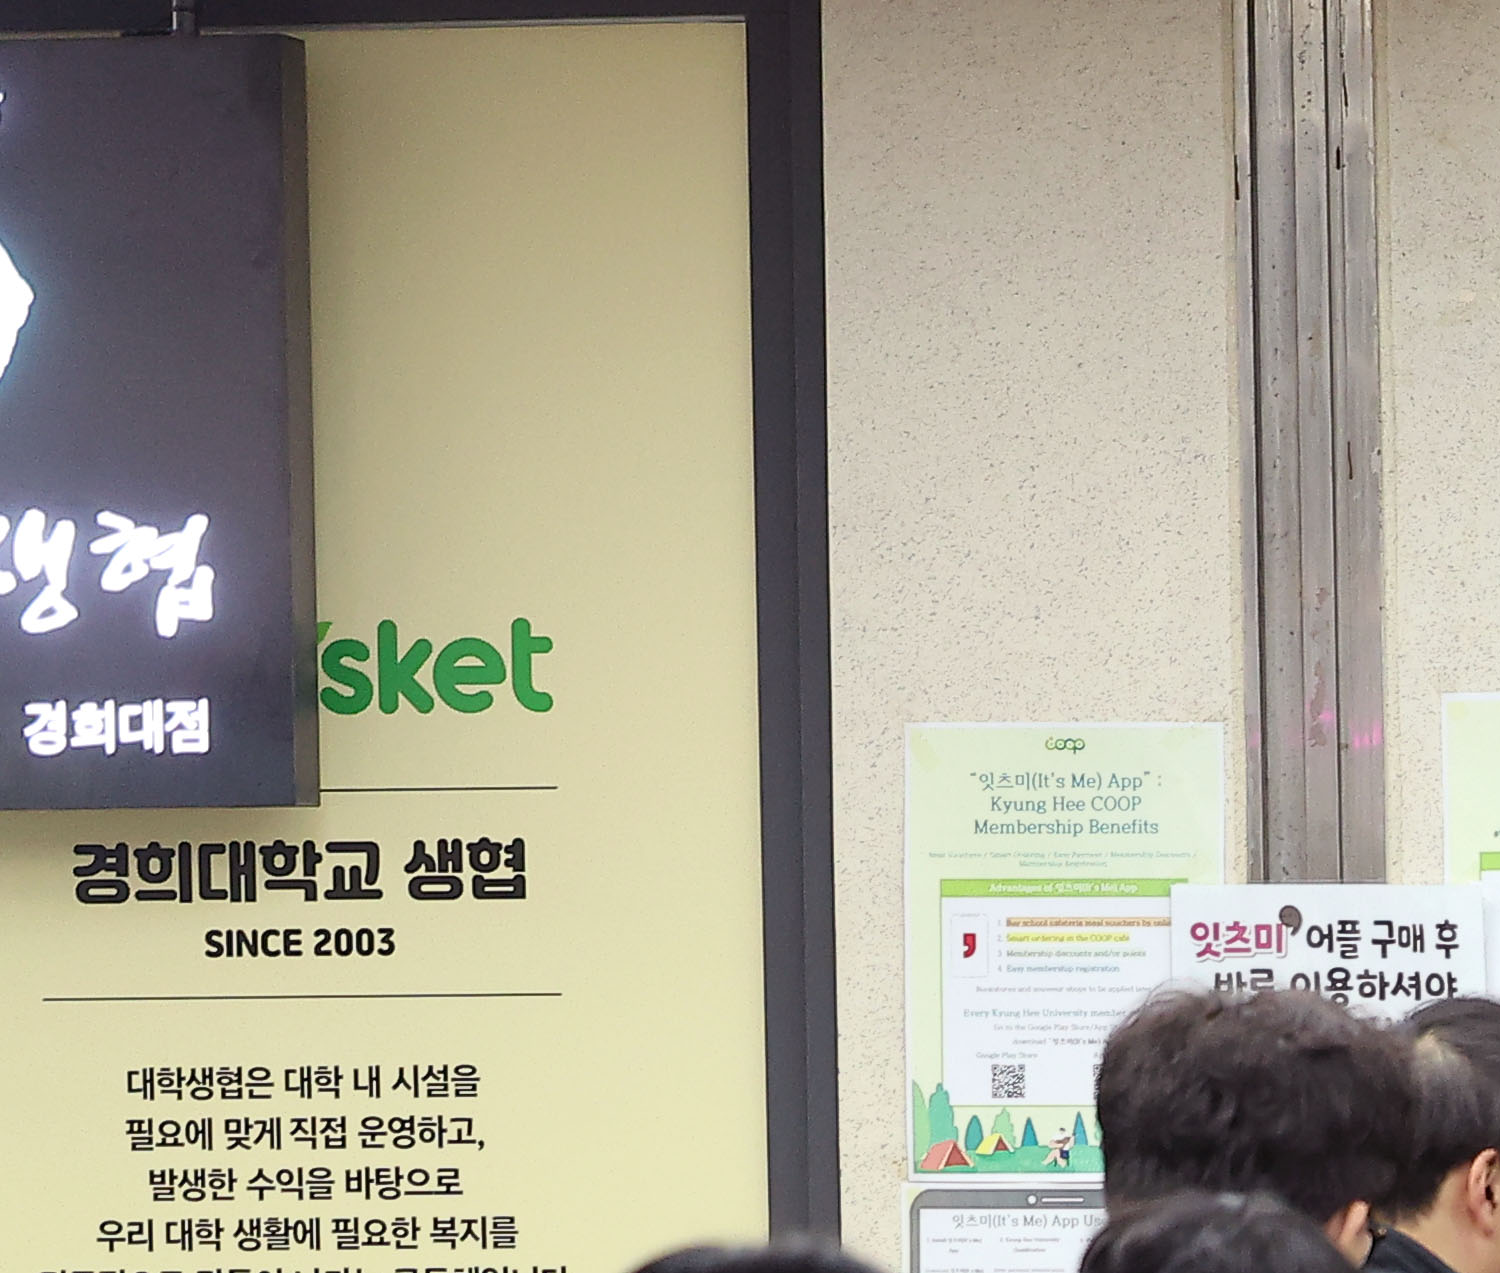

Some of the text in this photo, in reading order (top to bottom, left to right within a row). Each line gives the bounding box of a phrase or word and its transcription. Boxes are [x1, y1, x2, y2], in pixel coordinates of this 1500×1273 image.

[20, 696, 214, 758] 경희대점
[1071, 773, 1102, 790] Me)
[991, 796, 1141, 814] Kyung Hee COOP
[974, 819, 1158, 837] Membership Benefits
[72, 835, 530, 904] 경희대학교 생협
[205, 928, 395, 958] SINCE 2003
[1307, 920, 1361, 959] 어플
[1371, 920, 1424, 958] 구매
[1436, 920, 1459, 959] 후
[127, 1065, 480, 1101] 대학생협은 대학 내 시설을
[126, 1115, 484, 1151] 필요에 맞게 직접 운영하고,
[149, 1166, 463, 1202] 발생한 수익을 바탕으로
[97, 1216, 518, 1252] 우리 대학 생활에 필요한 복지를
[1024, 1215, 1047, 1228] Me)
[1052, 1215, 1079, 1229] App
